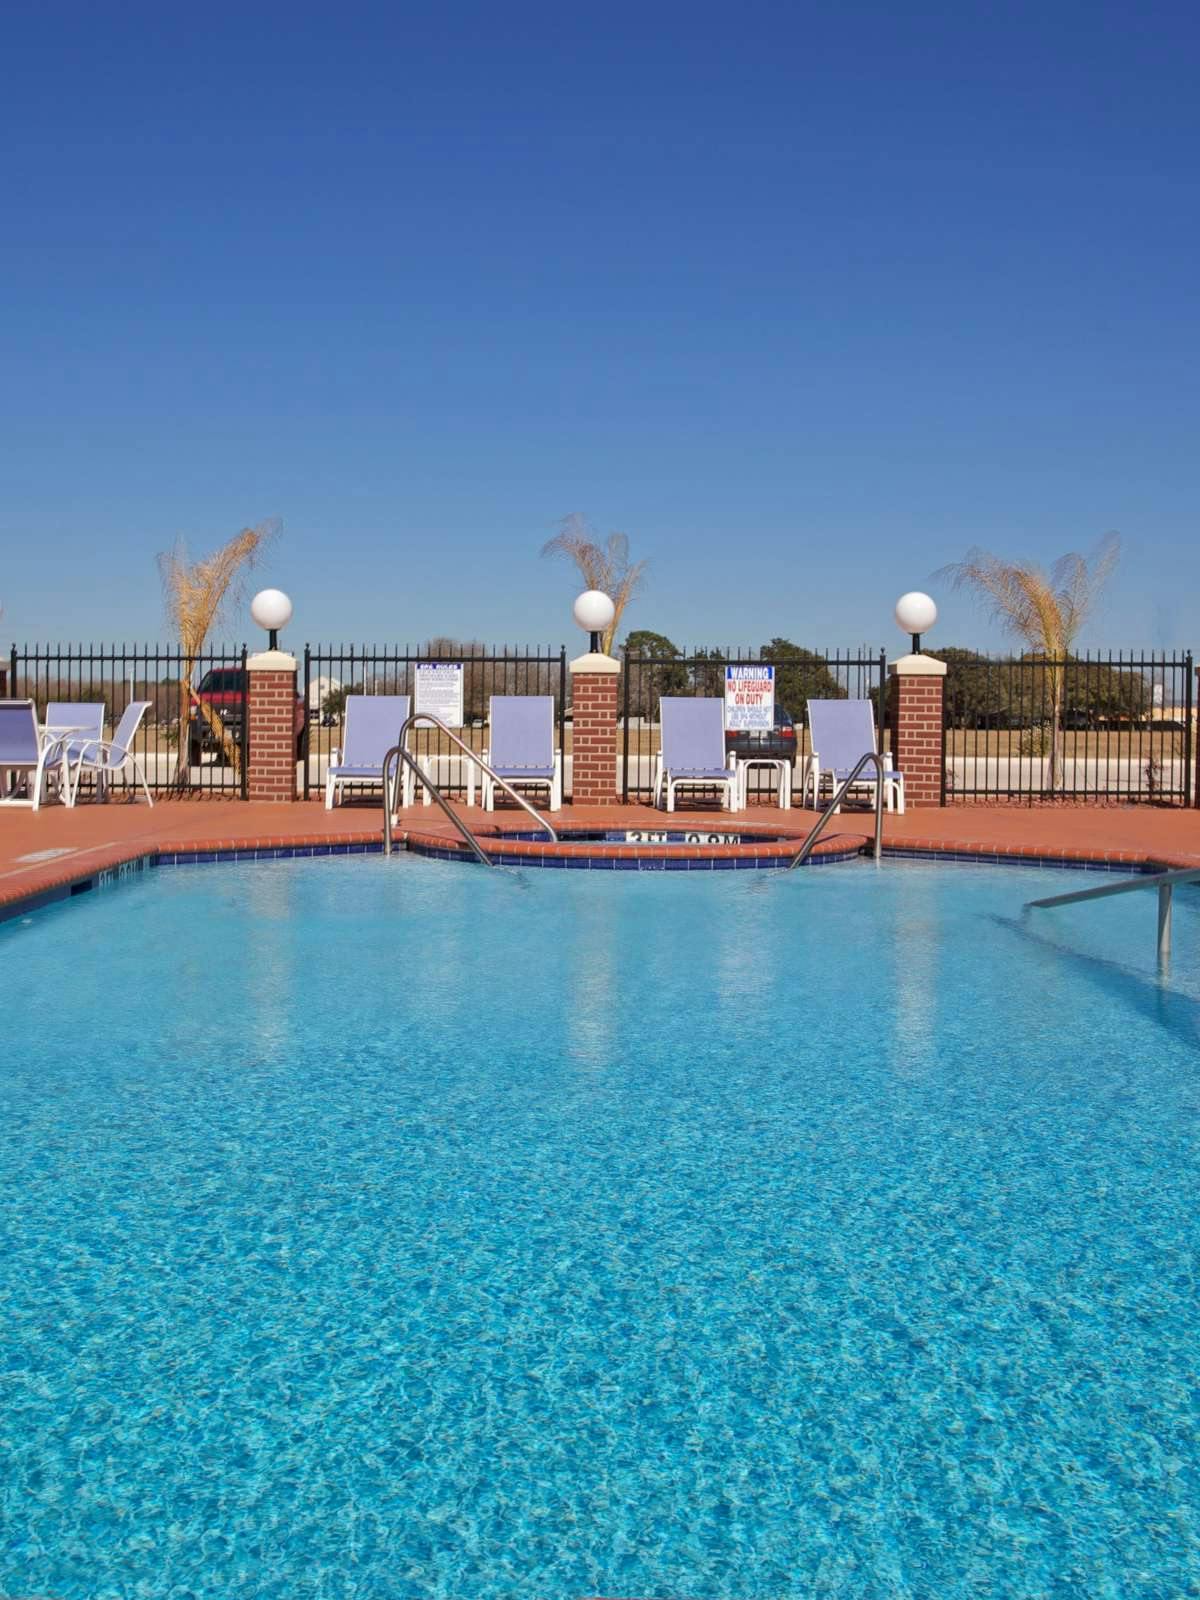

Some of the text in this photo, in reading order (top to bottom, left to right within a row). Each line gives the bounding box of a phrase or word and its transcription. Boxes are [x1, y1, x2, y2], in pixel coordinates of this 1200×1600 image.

[731, 667, 769, 679] WARNING
[728, 681, 771, 692] NO LIFEGUARD
[735, 694, 763, 704] ON DUTY
